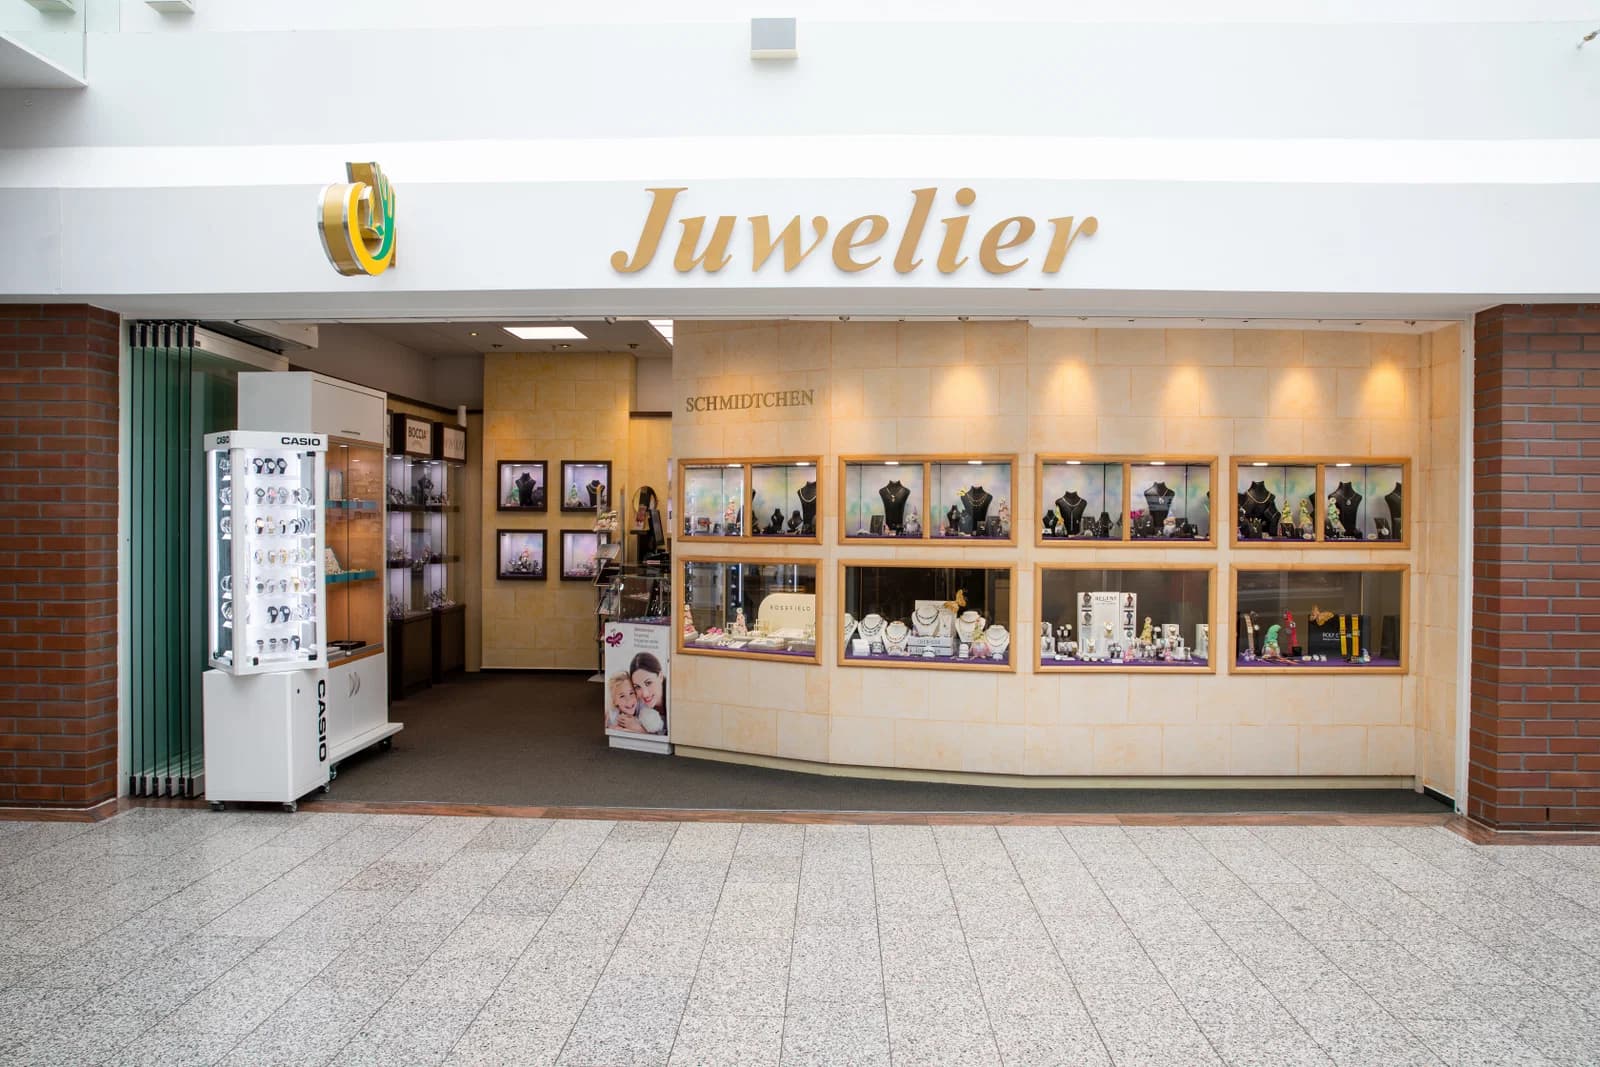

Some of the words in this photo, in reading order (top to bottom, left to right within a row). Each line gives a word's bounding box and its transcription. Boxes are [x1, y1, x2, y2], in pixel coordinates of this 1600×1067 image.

[610, 187, 1098, 274] Juwelier
[686, 389, 815, 413] SCHMIDTCHEN
[281, 436, 321, 447] CASIO
[408, 426, 427, 440] BOCCIA
[318, 679, 327, 762] CASIO
